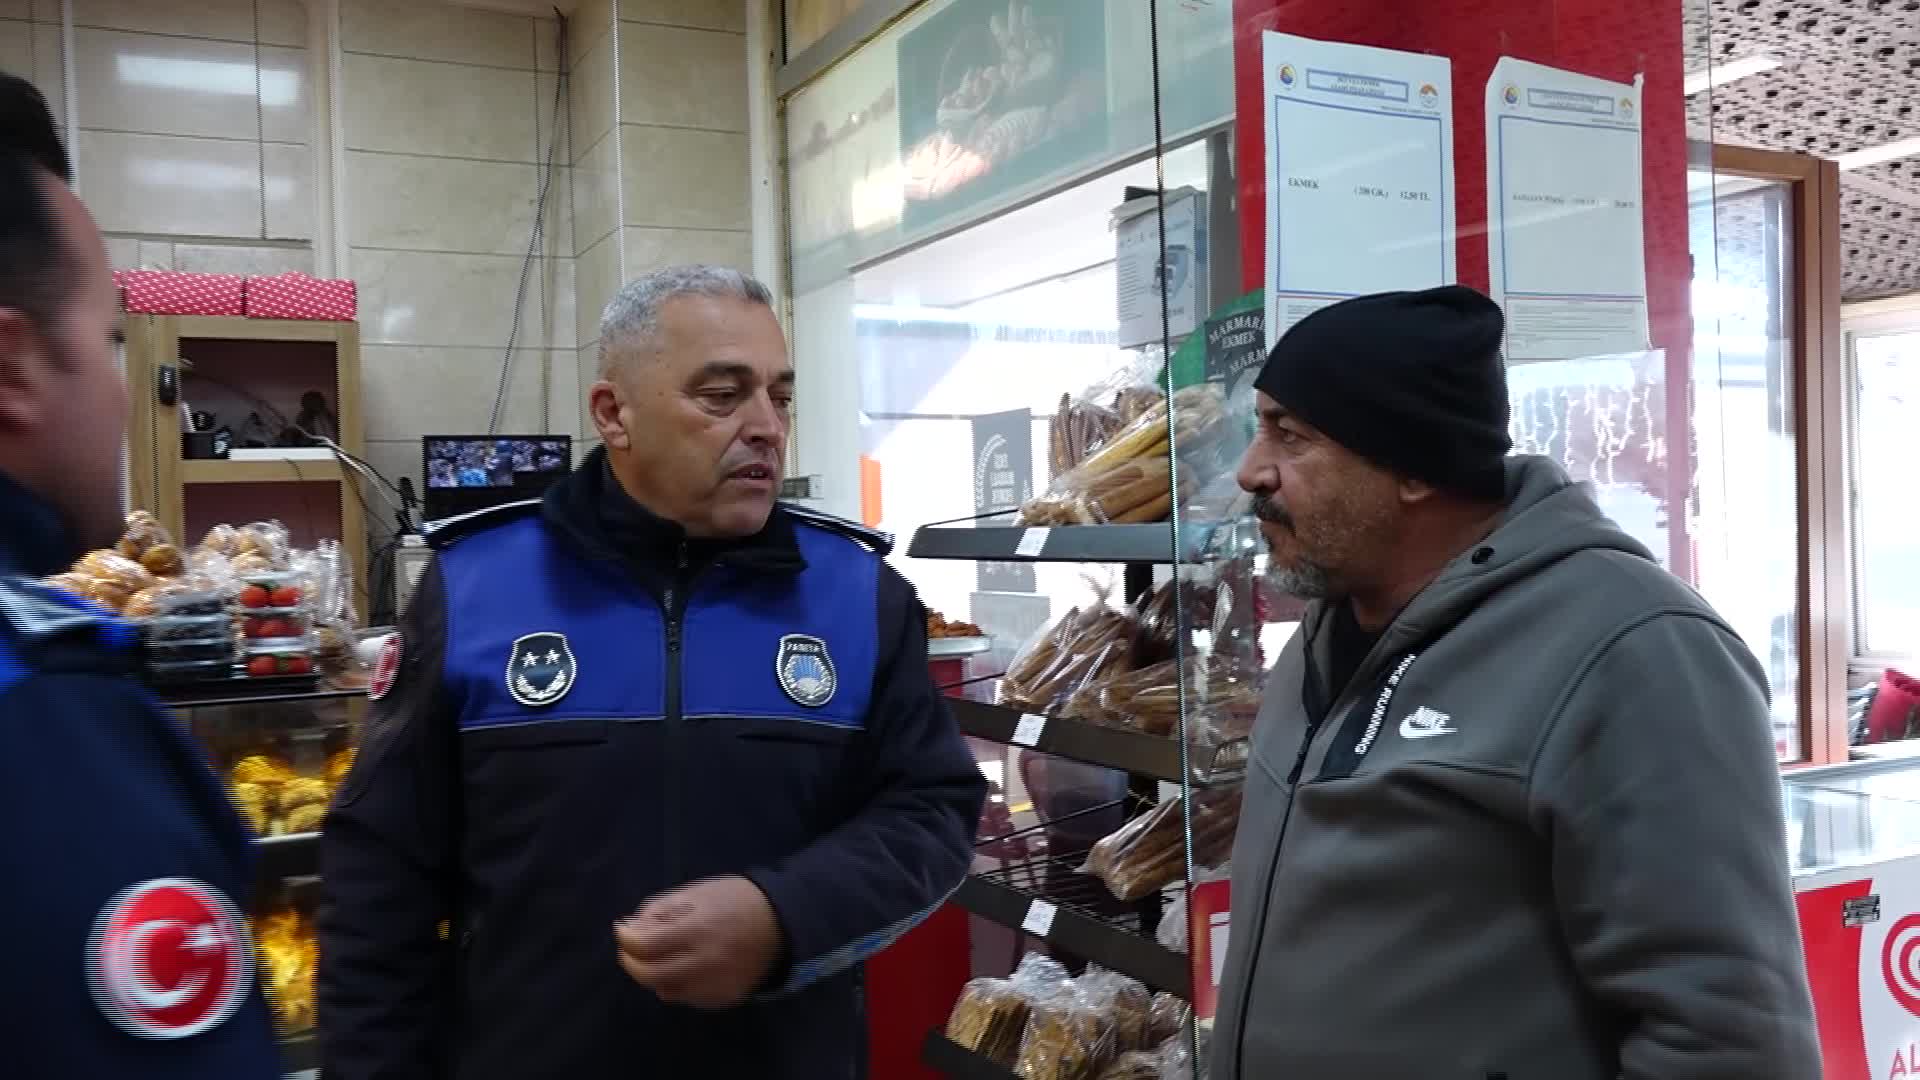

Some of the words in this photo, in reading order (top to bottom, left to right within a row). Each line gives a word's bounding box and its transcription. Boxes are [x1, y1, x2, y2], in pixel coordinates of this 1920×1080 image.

[1288, 177, 1319, 190] EKMEK
[1222, 330, 1256, 349] EKMEK
[1388, 654, 1416, 686] NIKE
[1354, 686, 1392, 754] RUNNING
[1411, 705, 1451, 729] NIKE
